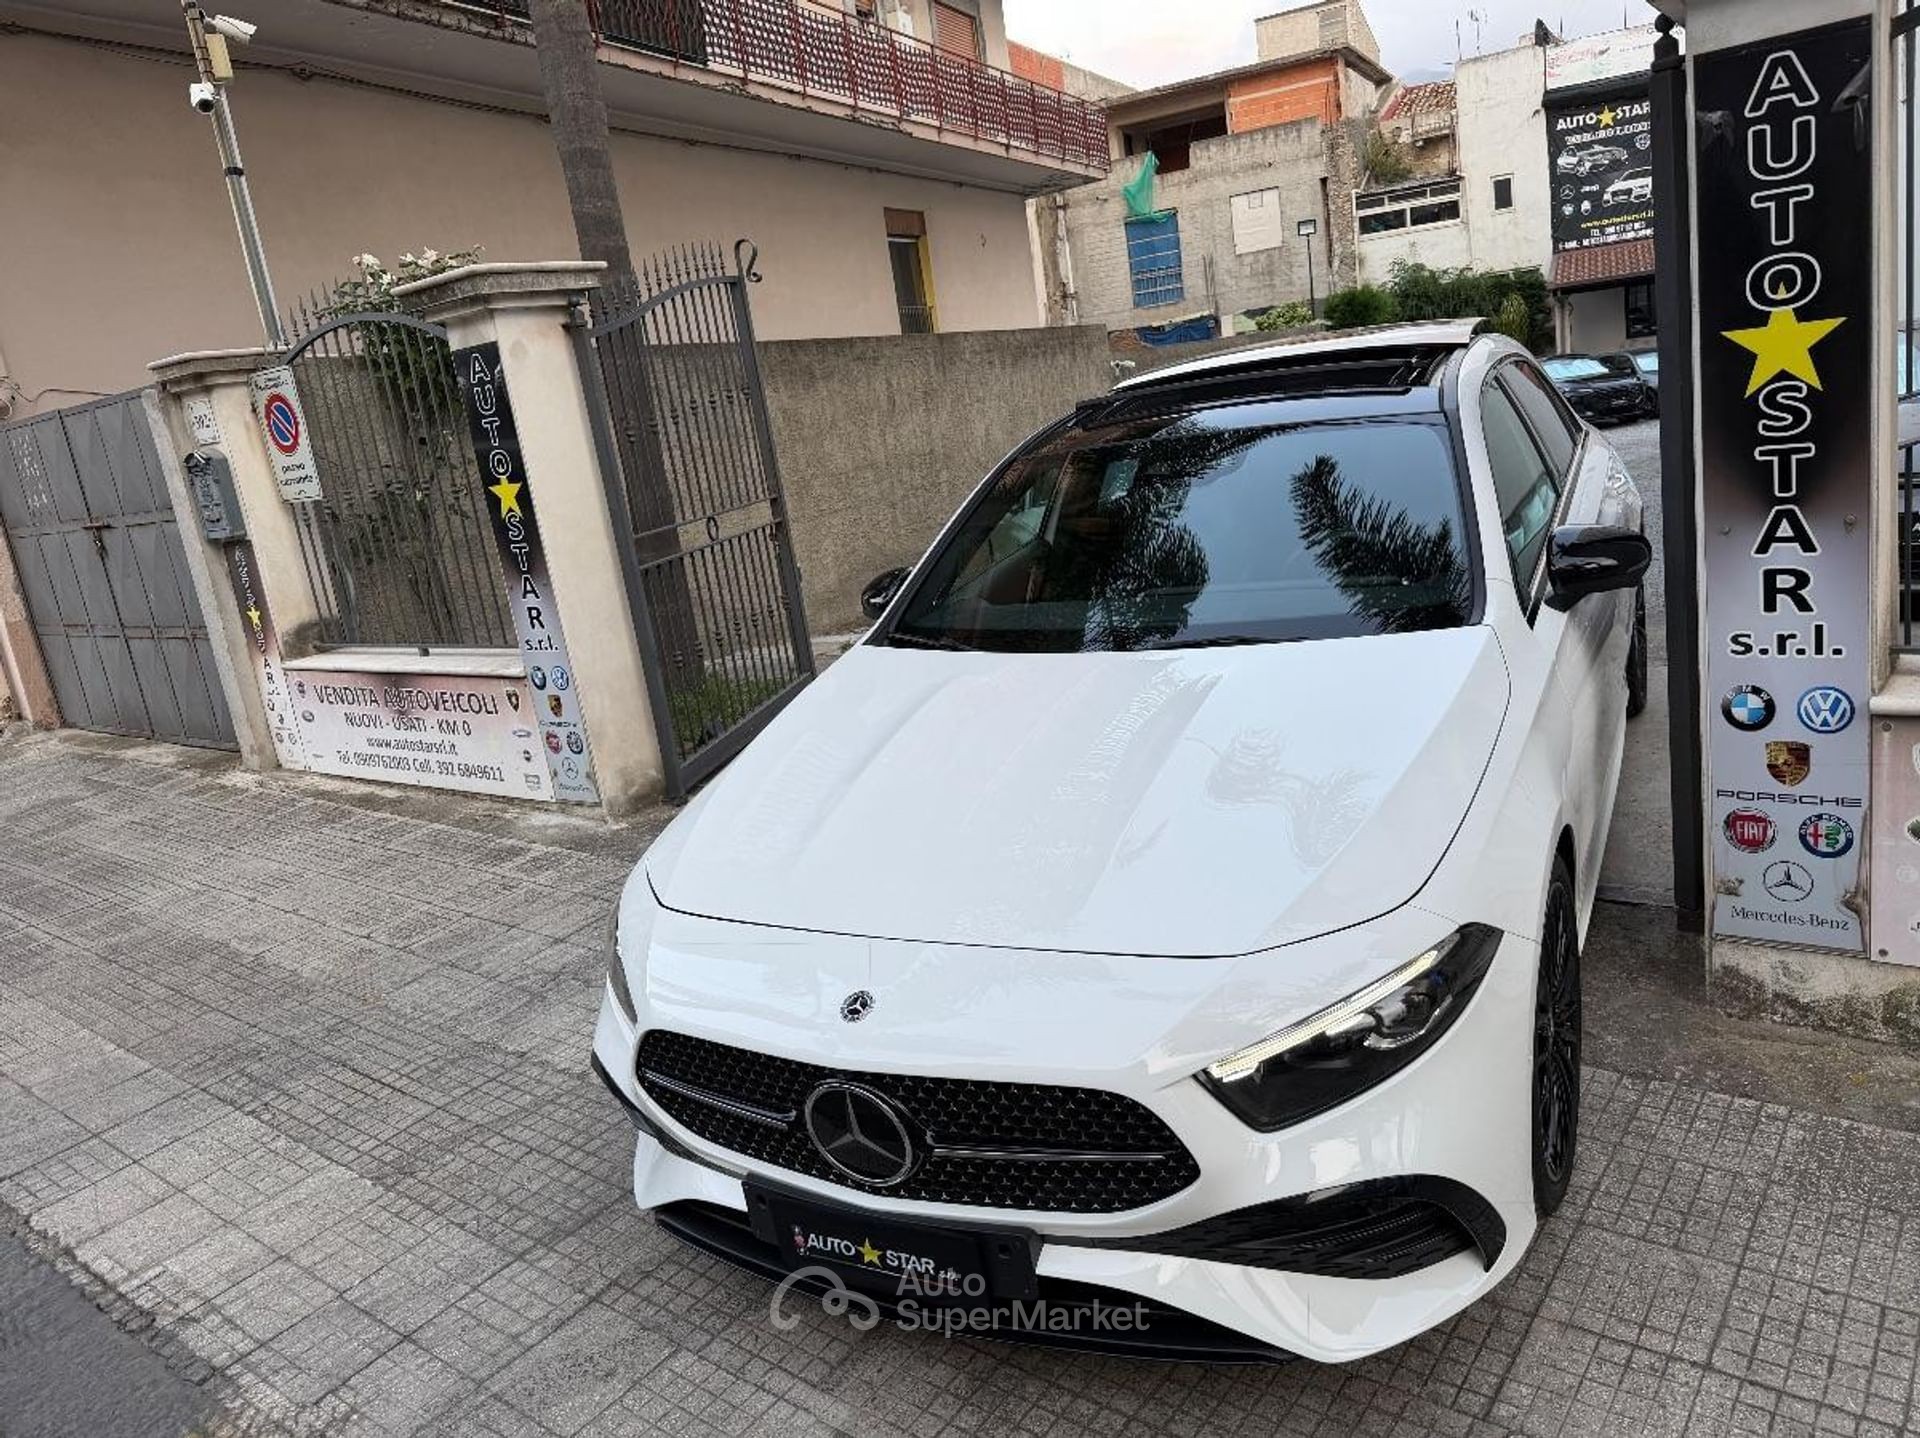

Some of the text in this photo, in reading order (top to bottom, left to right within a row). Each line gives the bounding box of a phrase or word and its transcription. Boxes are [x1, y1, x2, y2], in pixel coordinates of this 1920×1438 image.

[1556, 112, 1597, 131] AUTO
[1744, 50, 1821, 614] AUTO STAR
[470, 353, 545, 630] AUTO STAR
[1729, 622, 1844, 657] s.r.l.
[313, 685, 499, 715] VENDITA AUTOVEICOLI
[344, 712, 384, 729] NUOVI
[392, 714, 427, 733] USATI
[437, 718, 460, 736] KM
[1716, 788, 1863, 808] PORSCHE
[1736, 820, 1767, 841] FIAT
[1731, 905, 1850, 931] Mercedes-Benz
[807, 1233, 857, 1257] AUTO
[886, 1249, 936, 1276] STAR
